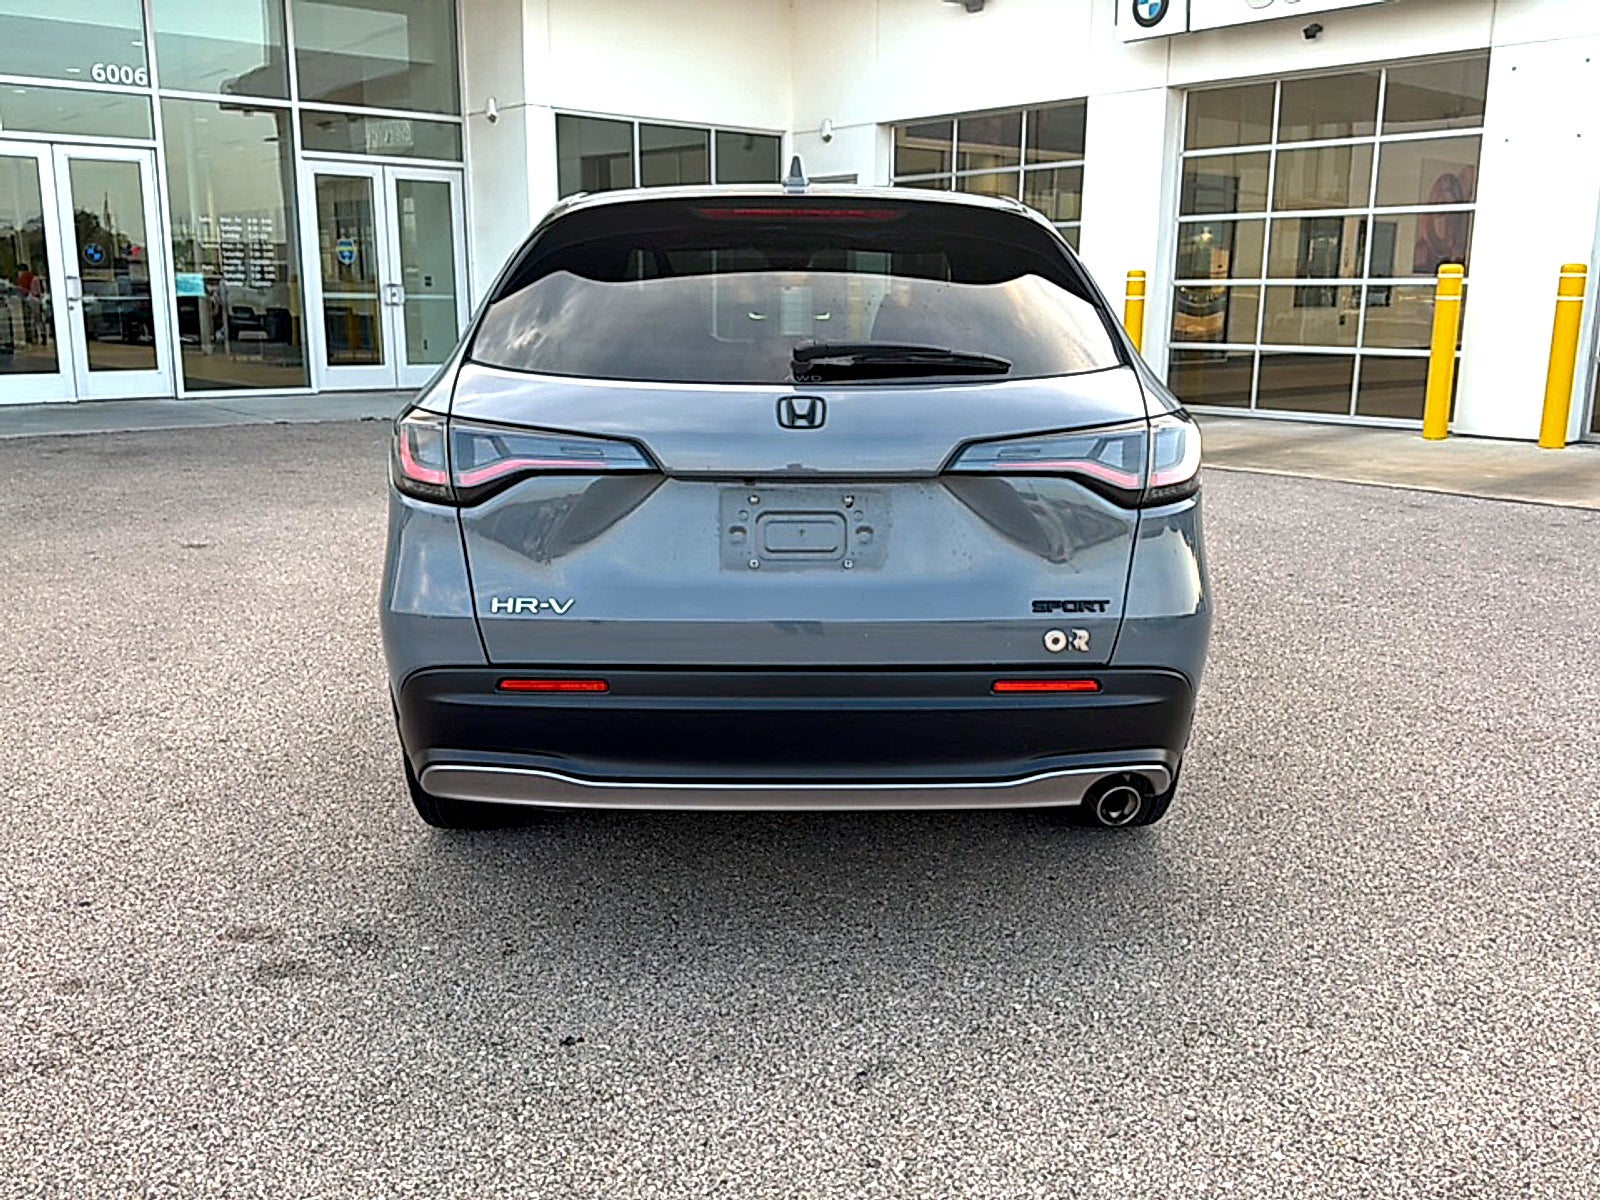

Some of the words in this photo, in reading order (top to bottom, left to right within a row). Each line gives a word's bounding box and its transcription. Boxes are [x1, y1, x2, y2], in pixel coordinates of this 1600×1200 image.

[91, 63, 148, 86] 6006
[490, 597, 575, 614] HR-V
[1031, 599, 1111, 613] SPORT
